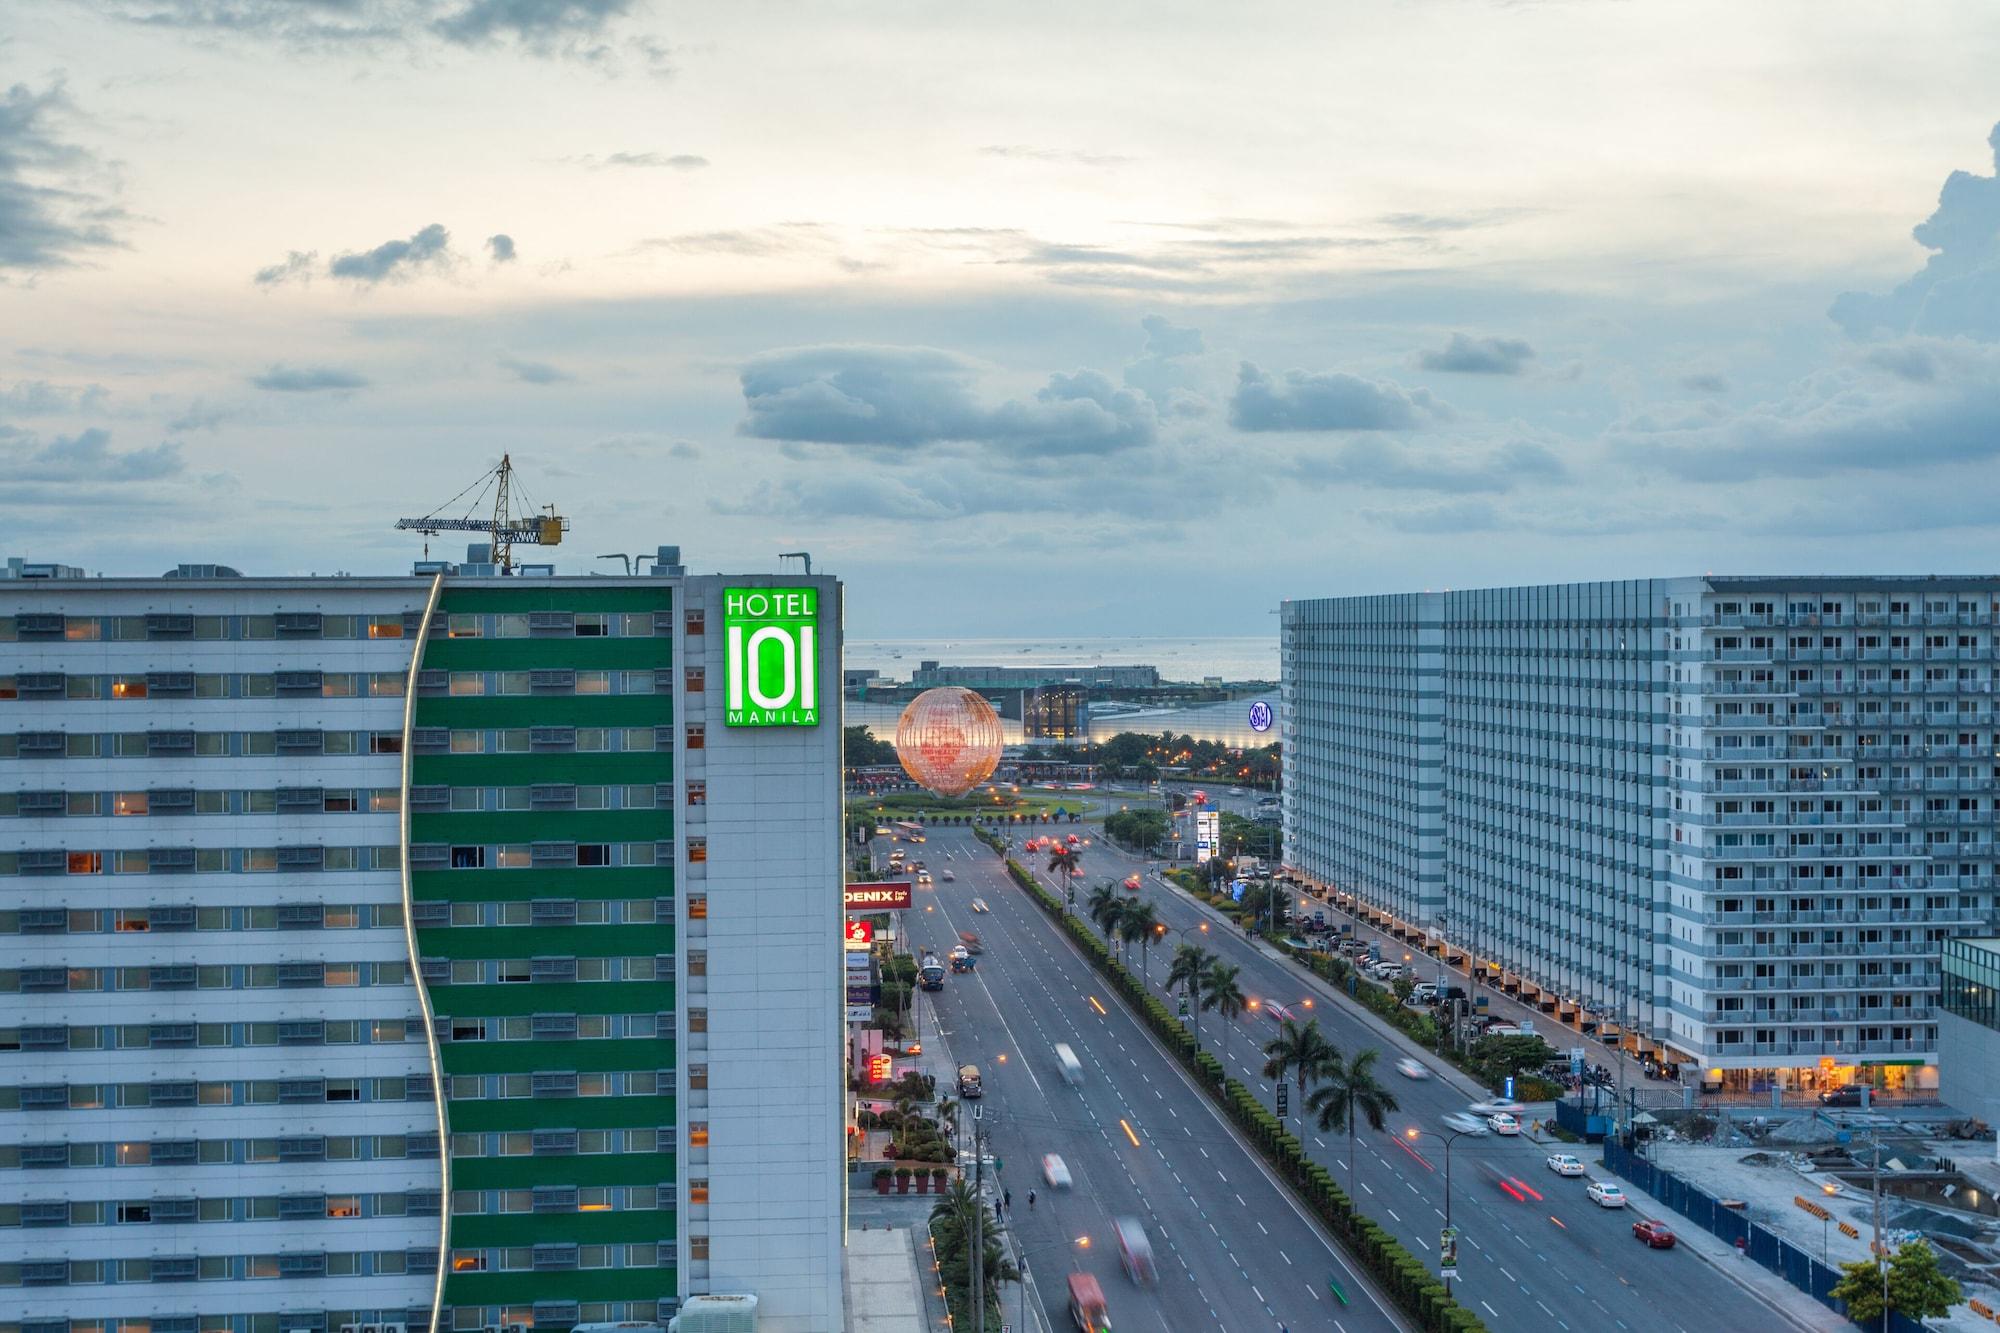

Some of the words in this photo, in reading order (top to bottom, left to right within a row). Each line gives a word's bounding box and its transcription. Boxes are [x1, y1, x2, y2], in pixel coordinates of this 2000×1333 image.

[728, 594, 813, 616] HOTEL
[729, 626, 814, 710] 101
[729, 710, 815, 724] MANILA
[1251, 705, 1267, 727] SM
